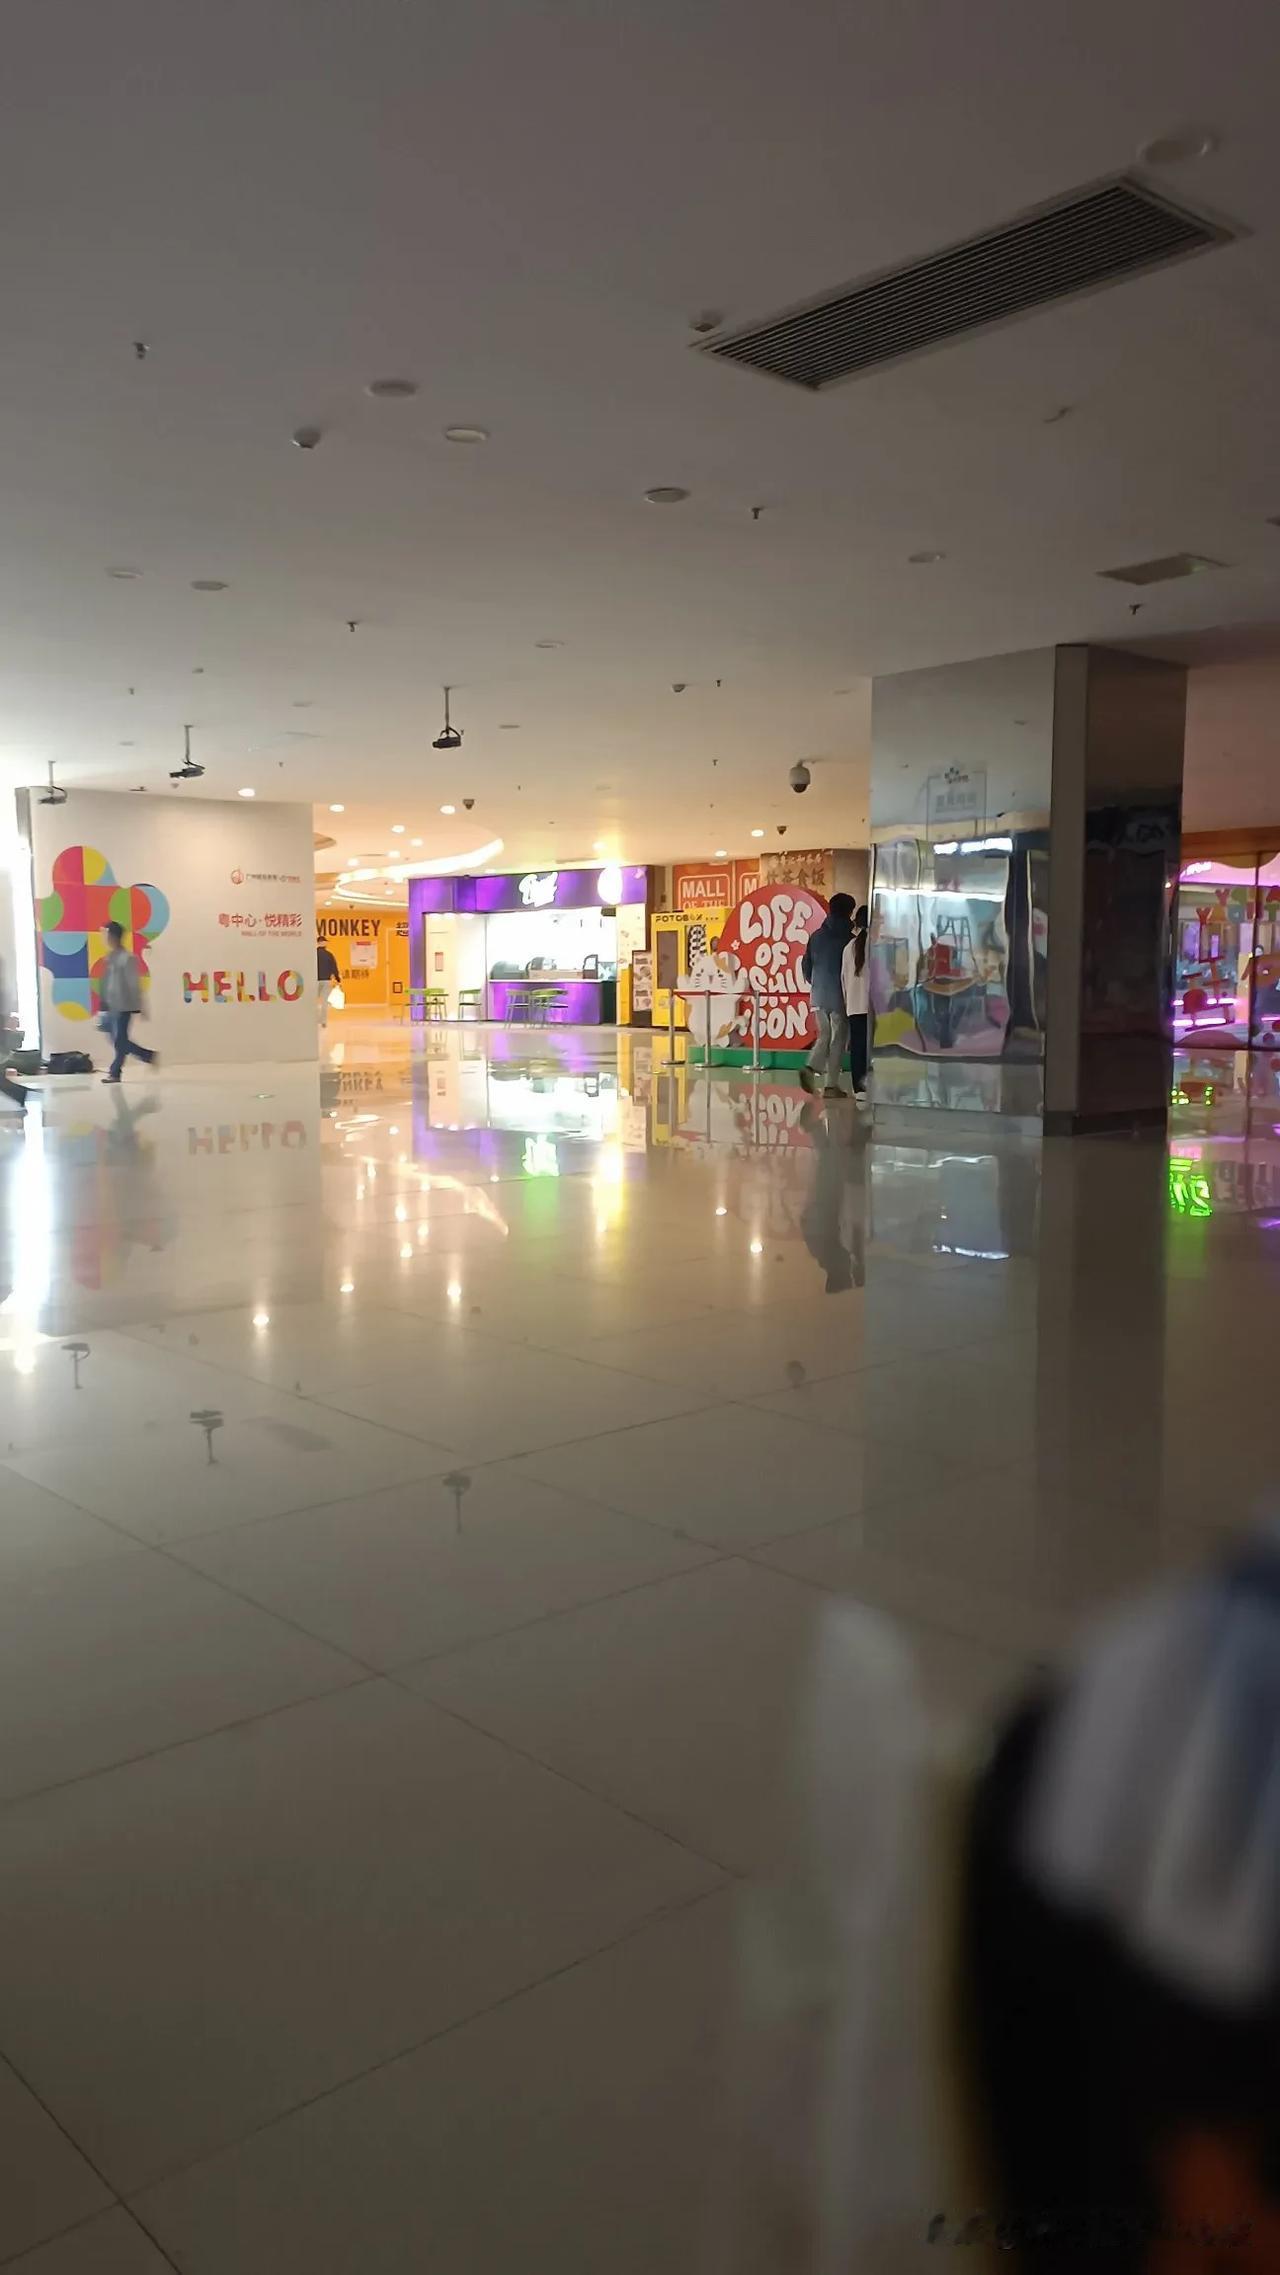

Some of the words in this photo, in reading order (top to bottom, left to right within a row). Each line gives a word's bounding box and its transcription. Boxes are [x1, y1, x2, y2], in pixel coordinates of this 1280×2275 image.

[682, 879, 726, 898] MALL
[316, 918, 381, 937] MONKEY
[740, 894, 813, 944] LIFE
[755, 942, 790, 976] OF
[182, 969, 304, 1004] HELLO
